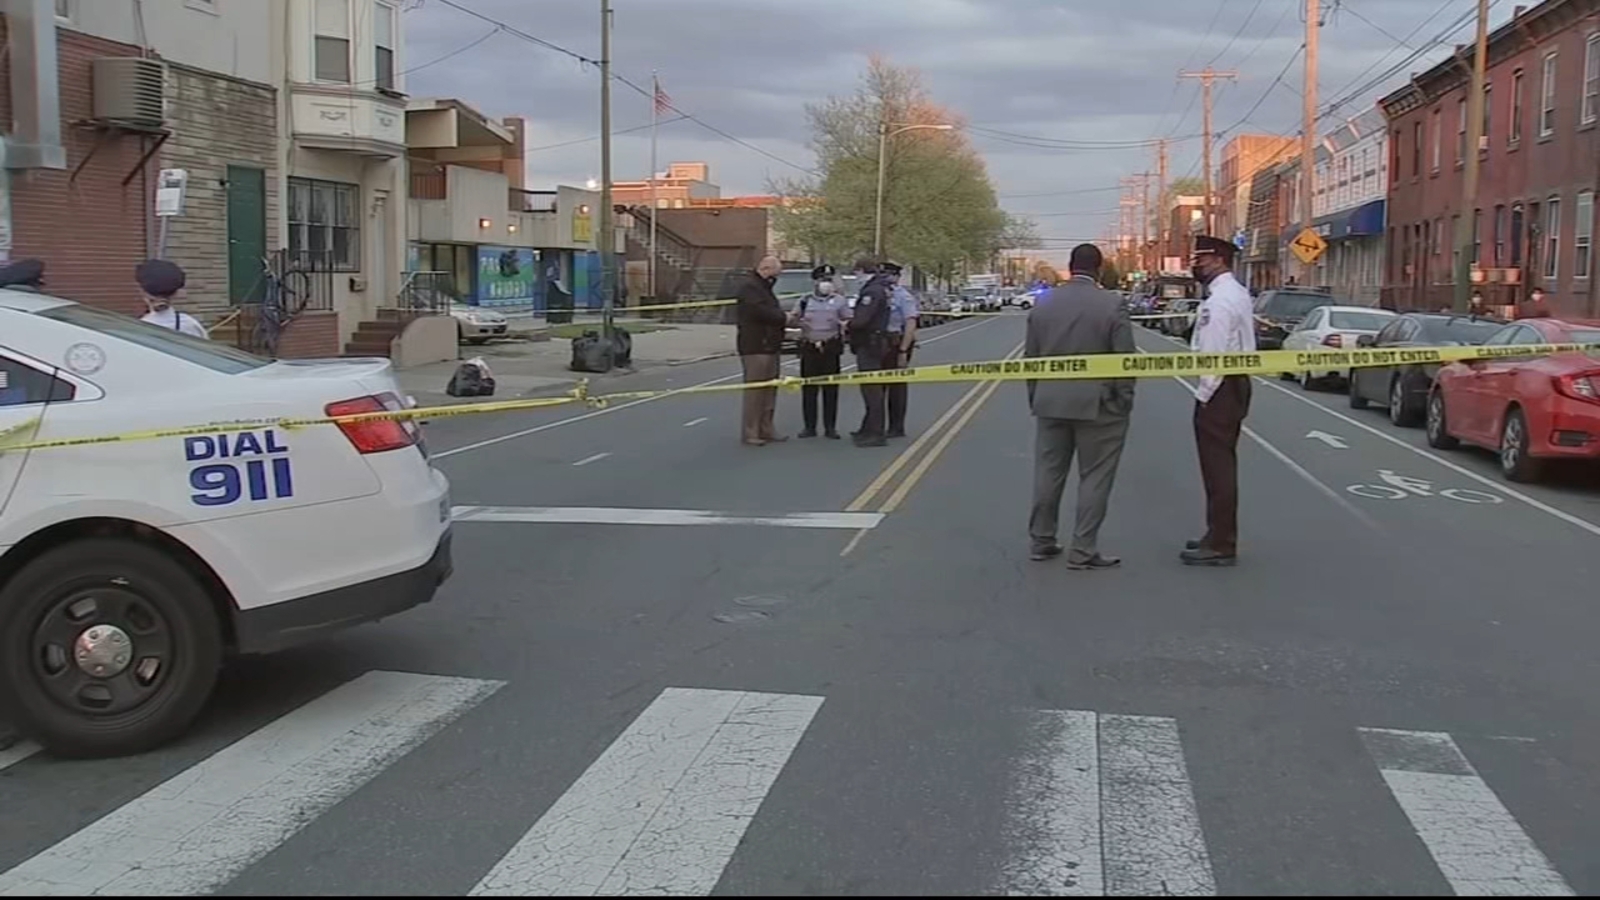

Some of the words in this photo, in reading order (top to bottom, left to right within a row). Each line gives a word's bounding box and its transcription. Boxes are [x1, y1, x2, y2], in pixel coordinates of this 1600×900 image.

[1122, 356, 1174, 371] CAUTION
[1177, 356, 1194, 370] DO
[1197, 355, 1219, 369] NOT
[1223, 354, 1261, 368] ENTER
[1297, 352, 1350, 366] CAUTION
[1352, 352, 1369, 364] DO
[1373, 351, 1396, 363] NOT
[1400, 350, 1440, 362] ENTER
[950, 363, 1001, 375] CAUTION
[1004, 361, 1021, 373] DO
[1023, 360, 1047, 372] NOT
[1050, 359, 1087, 372] ENTER
[184, 430, 288, 461] DIAL
[189, 457, 293, 506] 911
